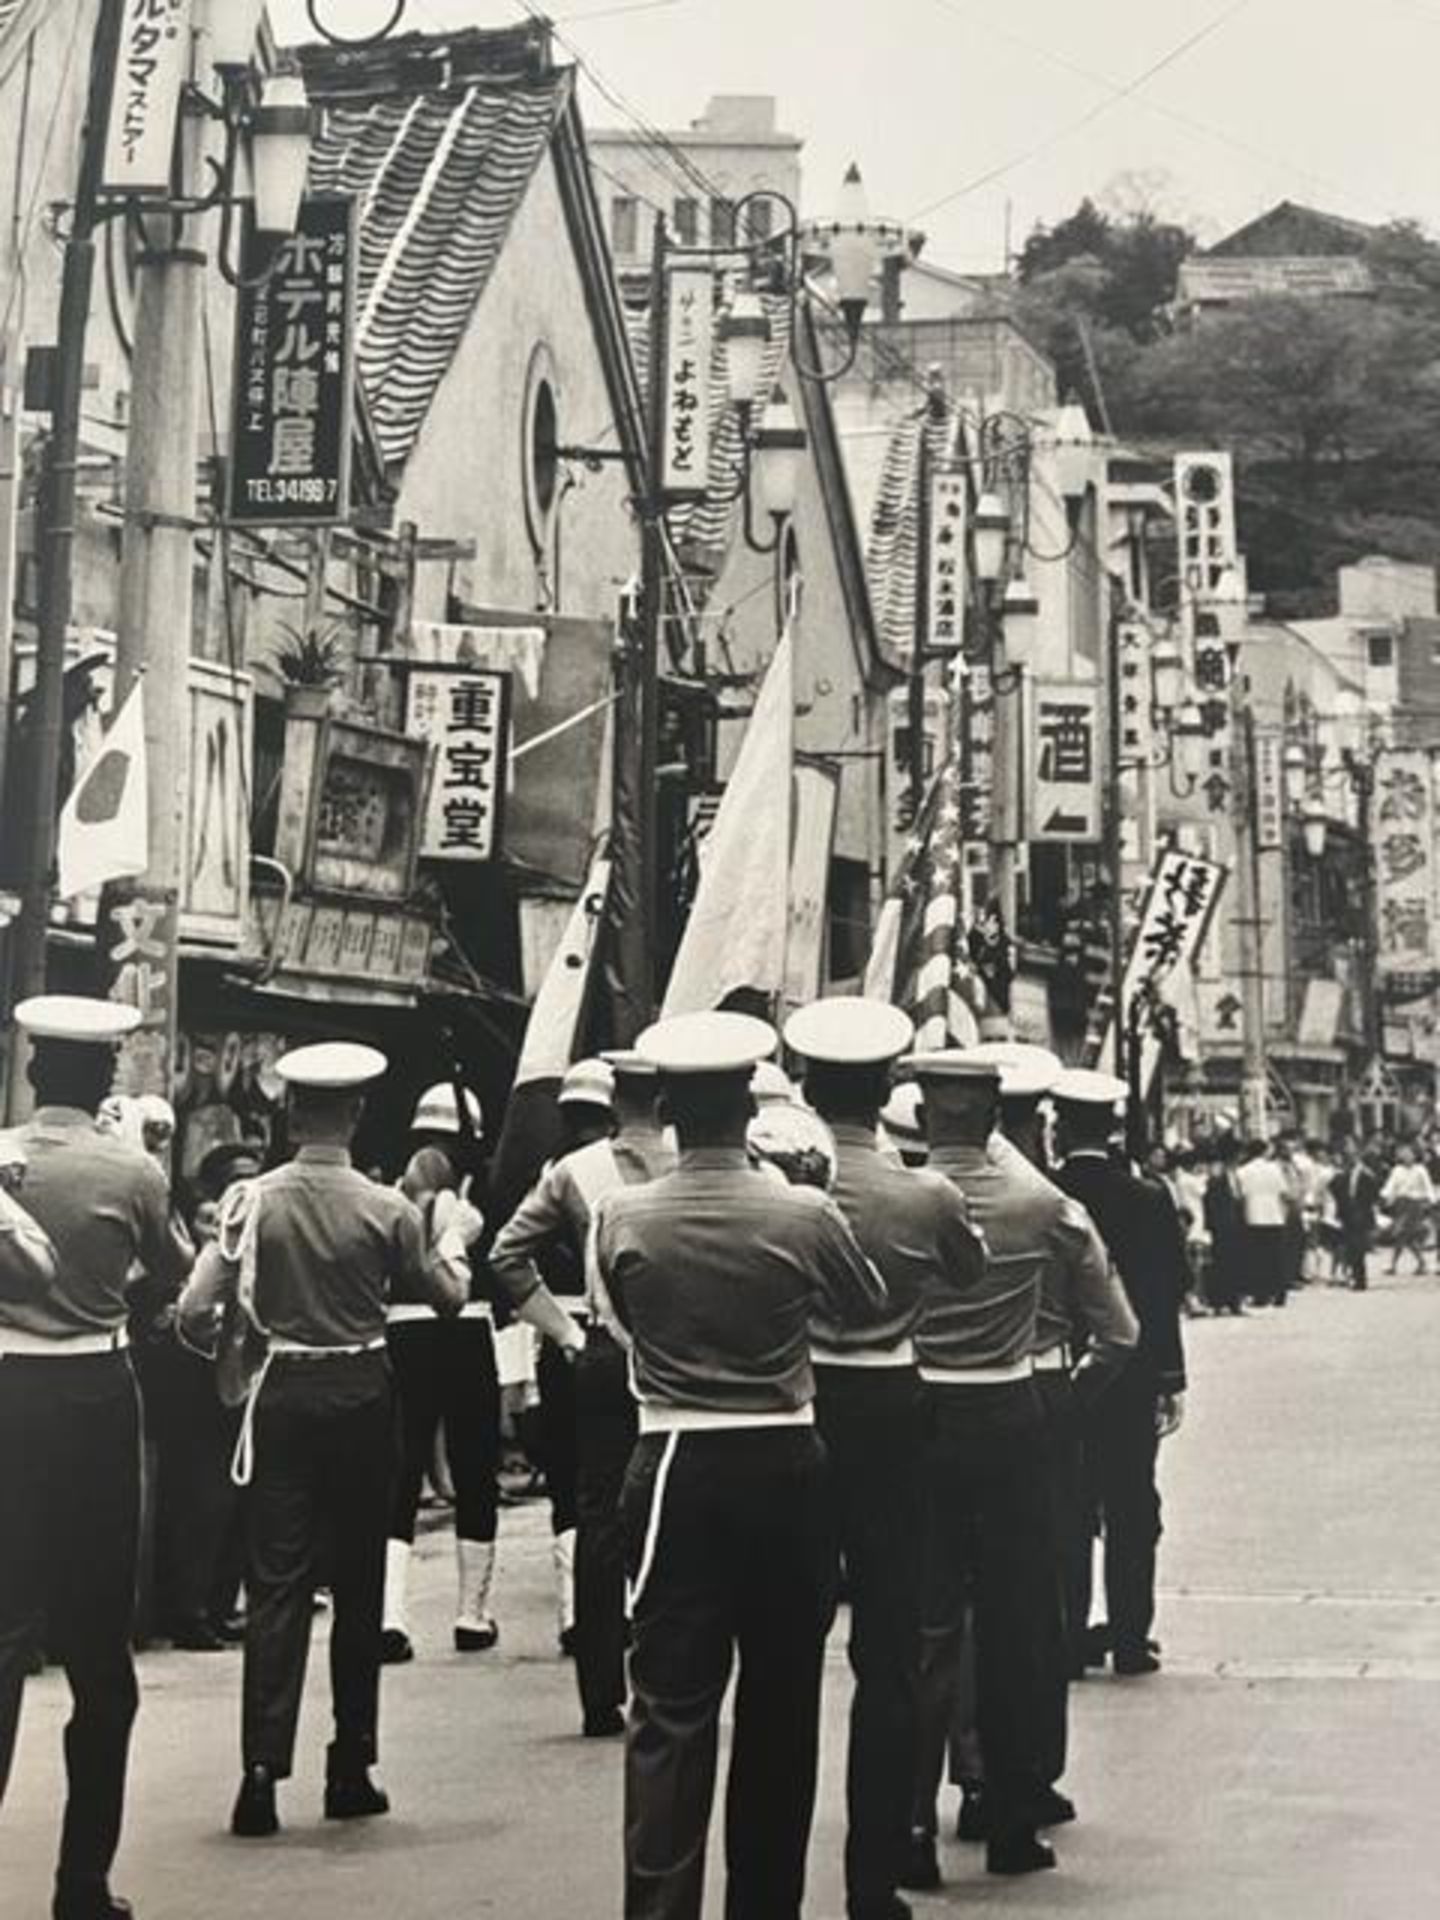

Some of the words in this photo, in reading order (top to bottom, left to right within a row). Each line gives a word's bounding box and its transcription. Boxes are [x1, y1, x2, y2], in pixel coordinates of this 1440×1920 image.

[267, 231, 326, 475] ホテル陣屋
[438, 680, 495, 850] 重宝堂
[1037, 702, 1092, 783] 酒
